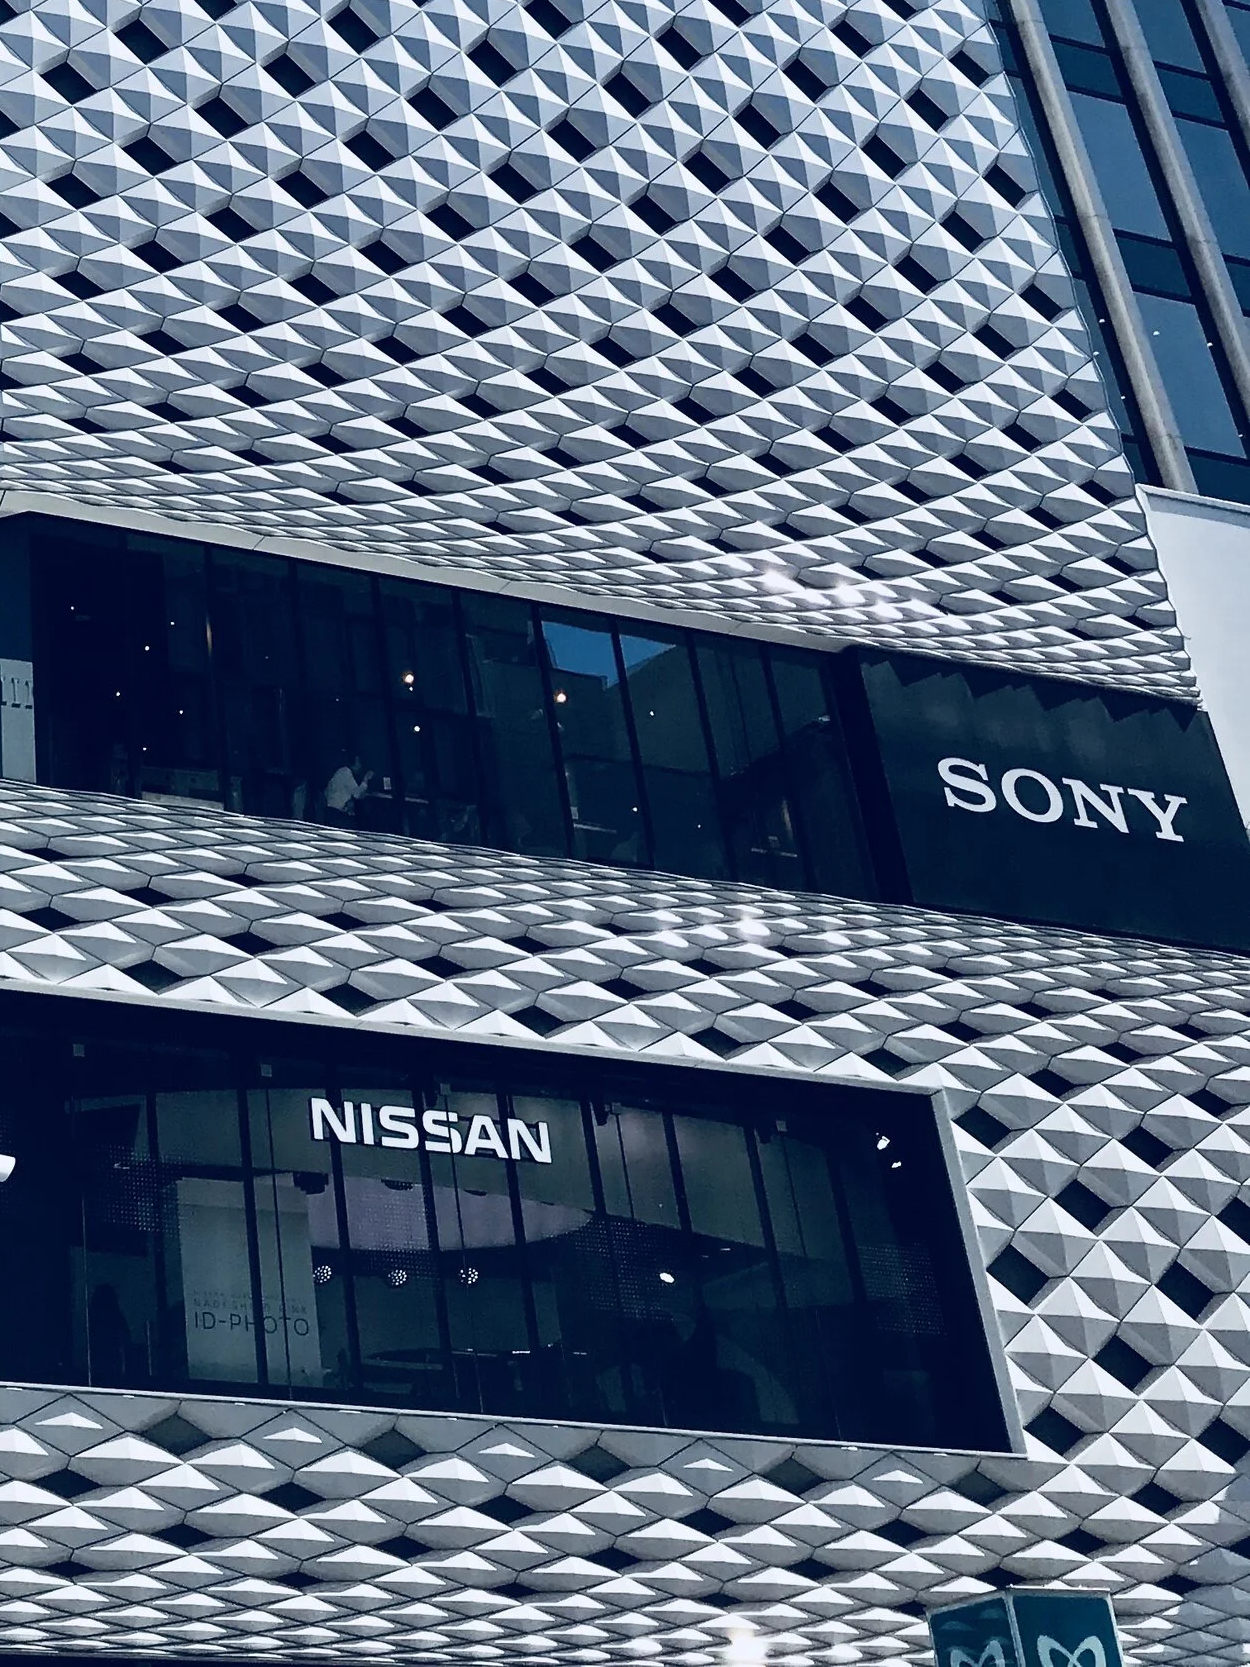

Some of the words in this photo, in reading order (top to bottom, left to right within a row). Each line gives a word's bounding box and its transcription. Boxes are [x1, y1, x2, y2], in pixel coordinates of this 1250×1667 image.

[937, 757, 1188, 842] SONY
[311, 1097, 552, 1163] NISSAN
[194, 1311, 309, 1335] ID-PHOTO
